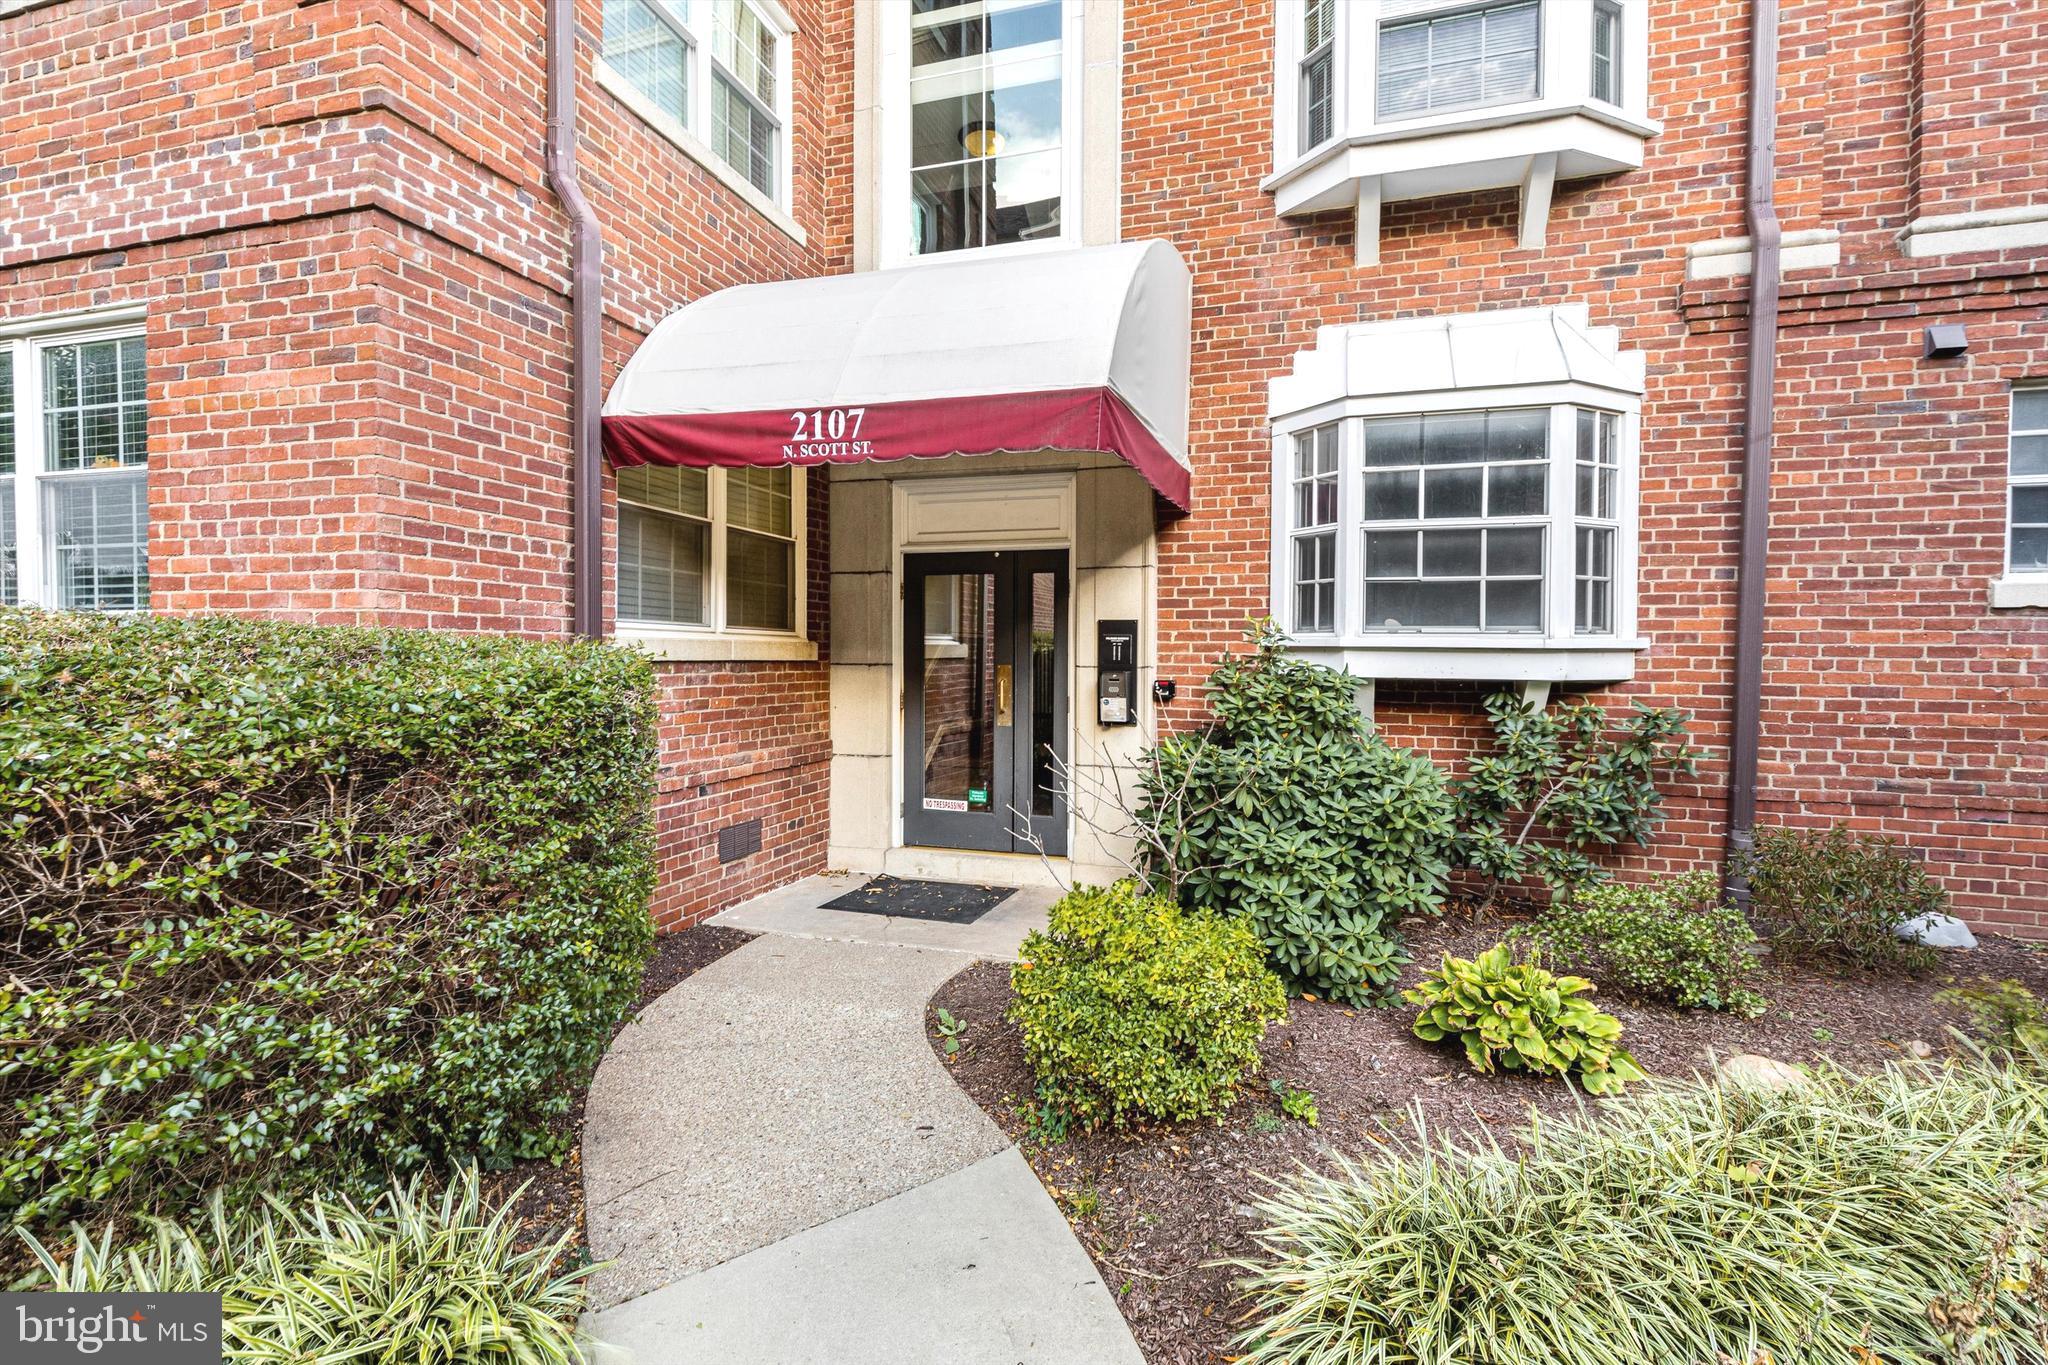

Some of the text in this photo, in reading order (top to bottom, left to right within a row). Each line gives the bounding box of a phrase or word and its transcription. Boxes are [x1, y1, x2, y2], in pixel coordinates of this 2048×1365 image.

[790, 408, 865, 441] 2107
[782, 441, 874, 459] N. SCOTT ST.
[925, 799, 965, 811] NO TRESPASSING
